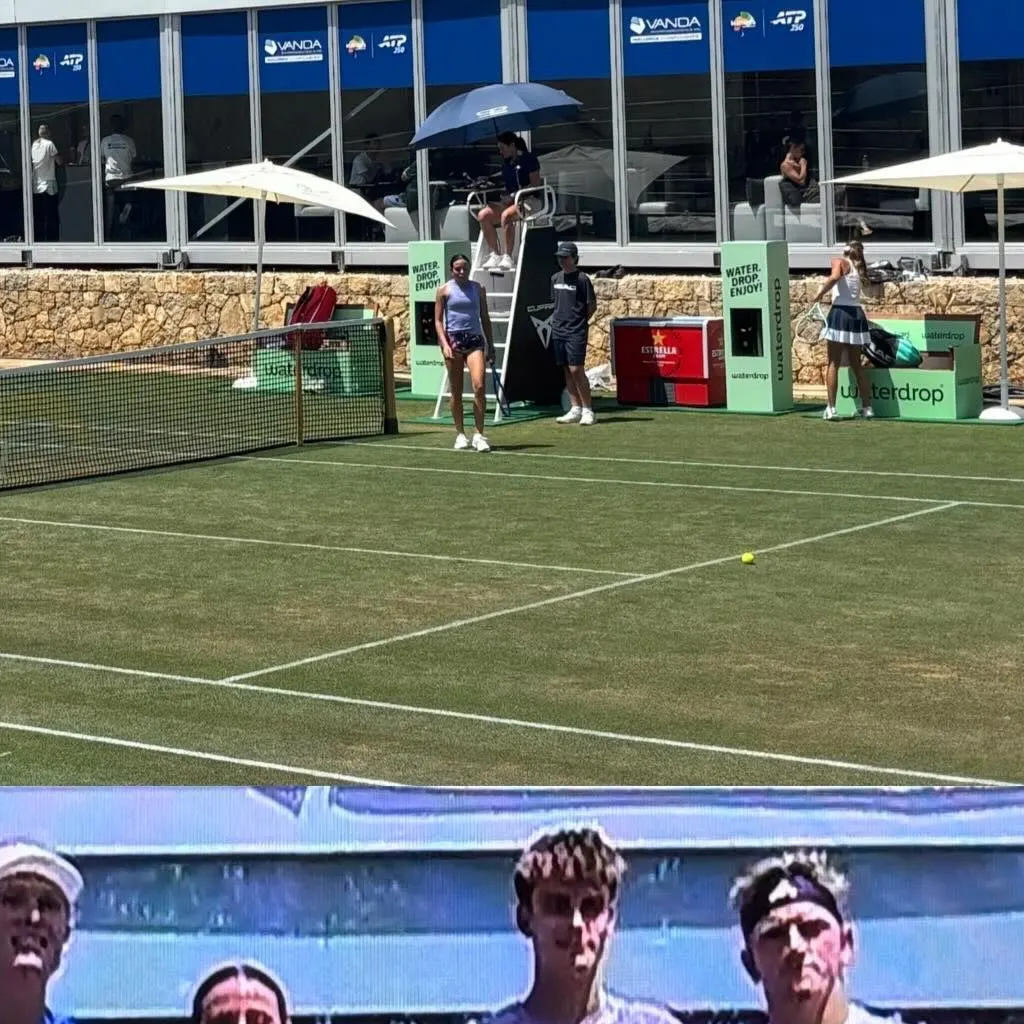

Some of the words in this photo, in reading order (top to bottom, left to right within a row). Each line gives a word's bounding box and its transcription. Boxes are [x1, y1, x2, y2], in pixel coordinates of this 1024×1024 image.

[646, 16, 701, 30] VANDA
[770, 10, 807, 25] ATP
[277, 39, 322, 51] VANDA
[378, 34, 407, 48] ATP
[60, 53, 83, 66] ATP
[412, 261, 440, 274] WATER.
[726, 263, 761, 278] WATER.
[416, 271, 438, 283] DROP.
[731, 274, 759, 287] DROP.
[415, 278, 441, 292] ENJOY!
[730, 283, 763, 297] ENJOY!
[641, 346, 677, 354] ESTRELLA
[732, 372, 769, 380] waterdrop
[841, 383, 944, 405] wterdrop
